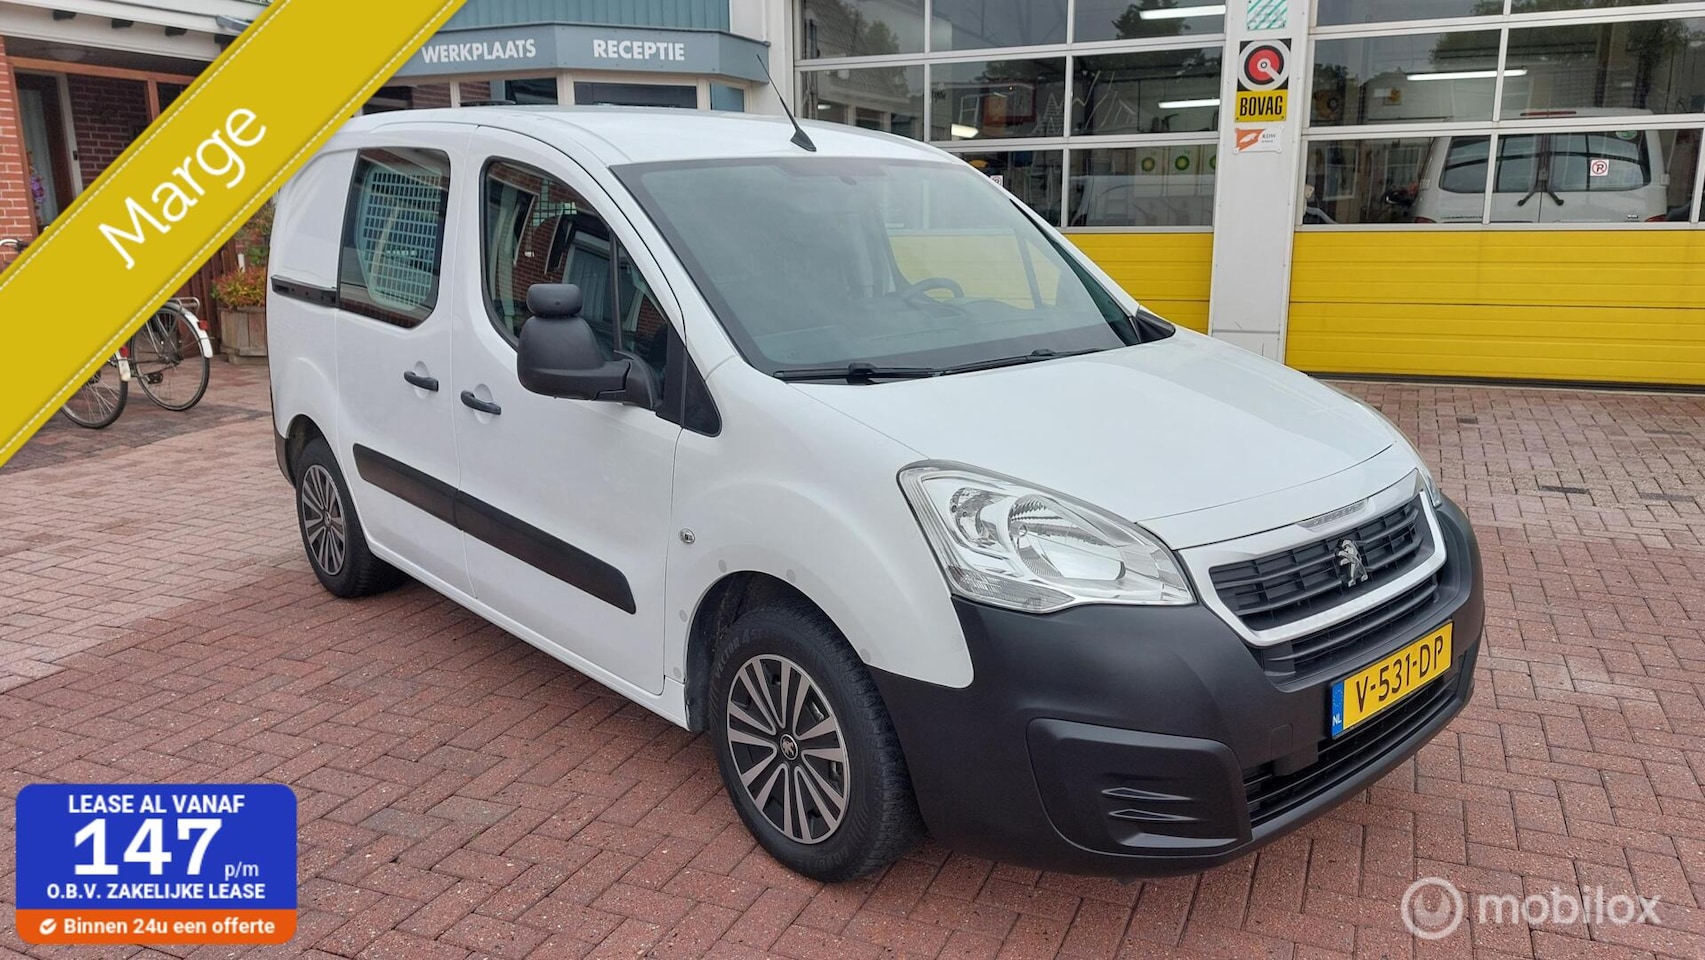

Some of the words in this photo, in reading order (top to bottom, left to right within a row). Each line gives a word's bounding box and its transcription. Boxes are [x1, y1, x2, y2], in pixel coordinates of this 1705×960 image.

[422, 38, 537, 63] WERKPLAATS
[593, 39, 685, 61] RECEPTIE
[1240, 95, 1283, 116] BOVAG
[1356, 635, 1444, 713] V-531-DP
[1332, 713, 1342, 727] NL
